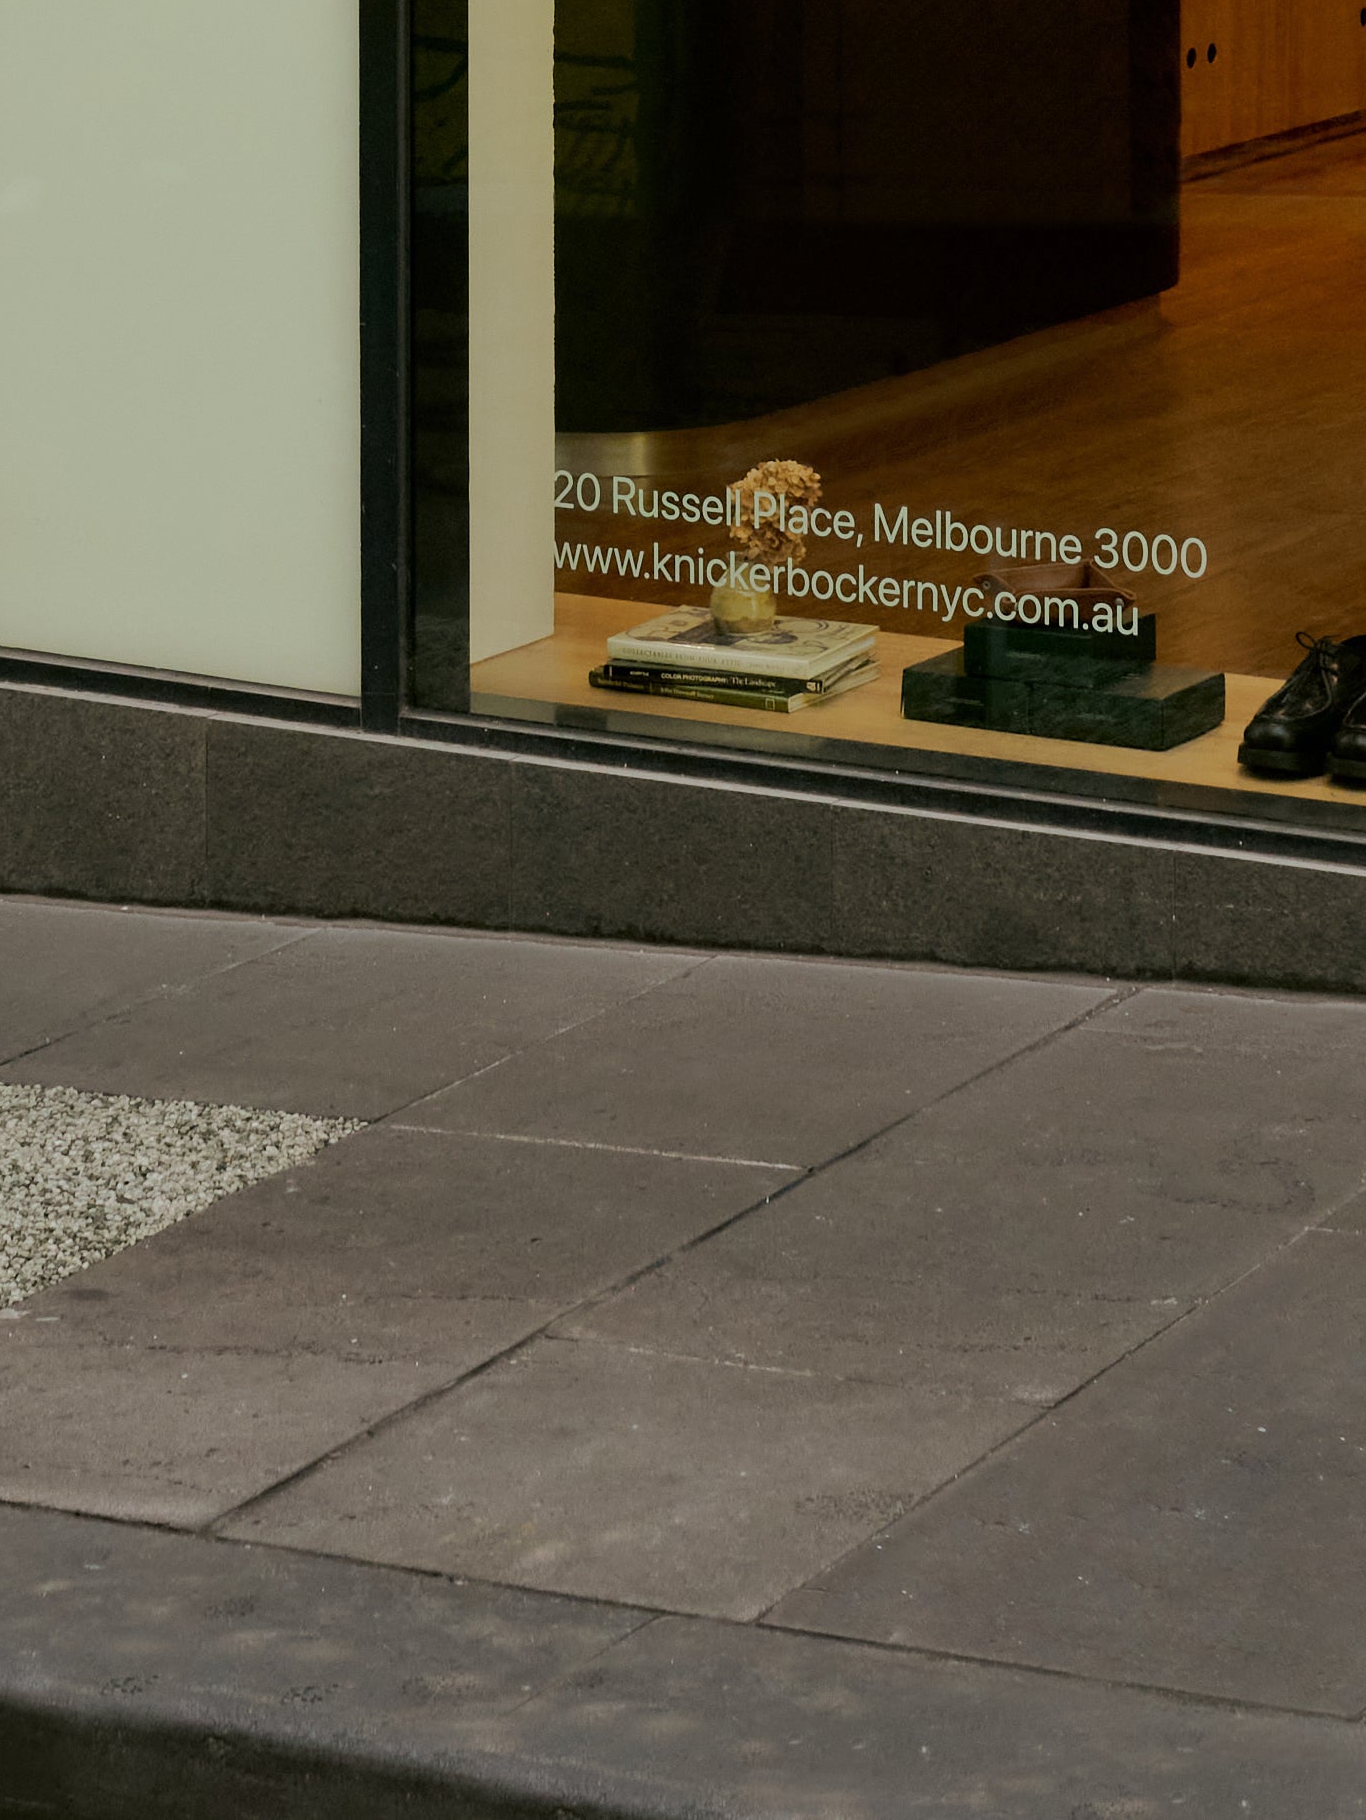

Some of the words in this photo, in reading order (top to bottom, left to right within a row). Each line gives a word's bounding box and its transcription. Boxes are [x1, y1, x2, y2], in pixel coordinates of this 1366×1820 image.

[554, 469, 601, 512] 20
[612, 476, 741, 528] Russell
[753, 490, 864, 548] Place,
[874, 502, 1083, 565] Melbourne
[1093, 527, 1208, 579] 3000
[554, 540, 1139, 637] www.knickerbockernyc.com.au
